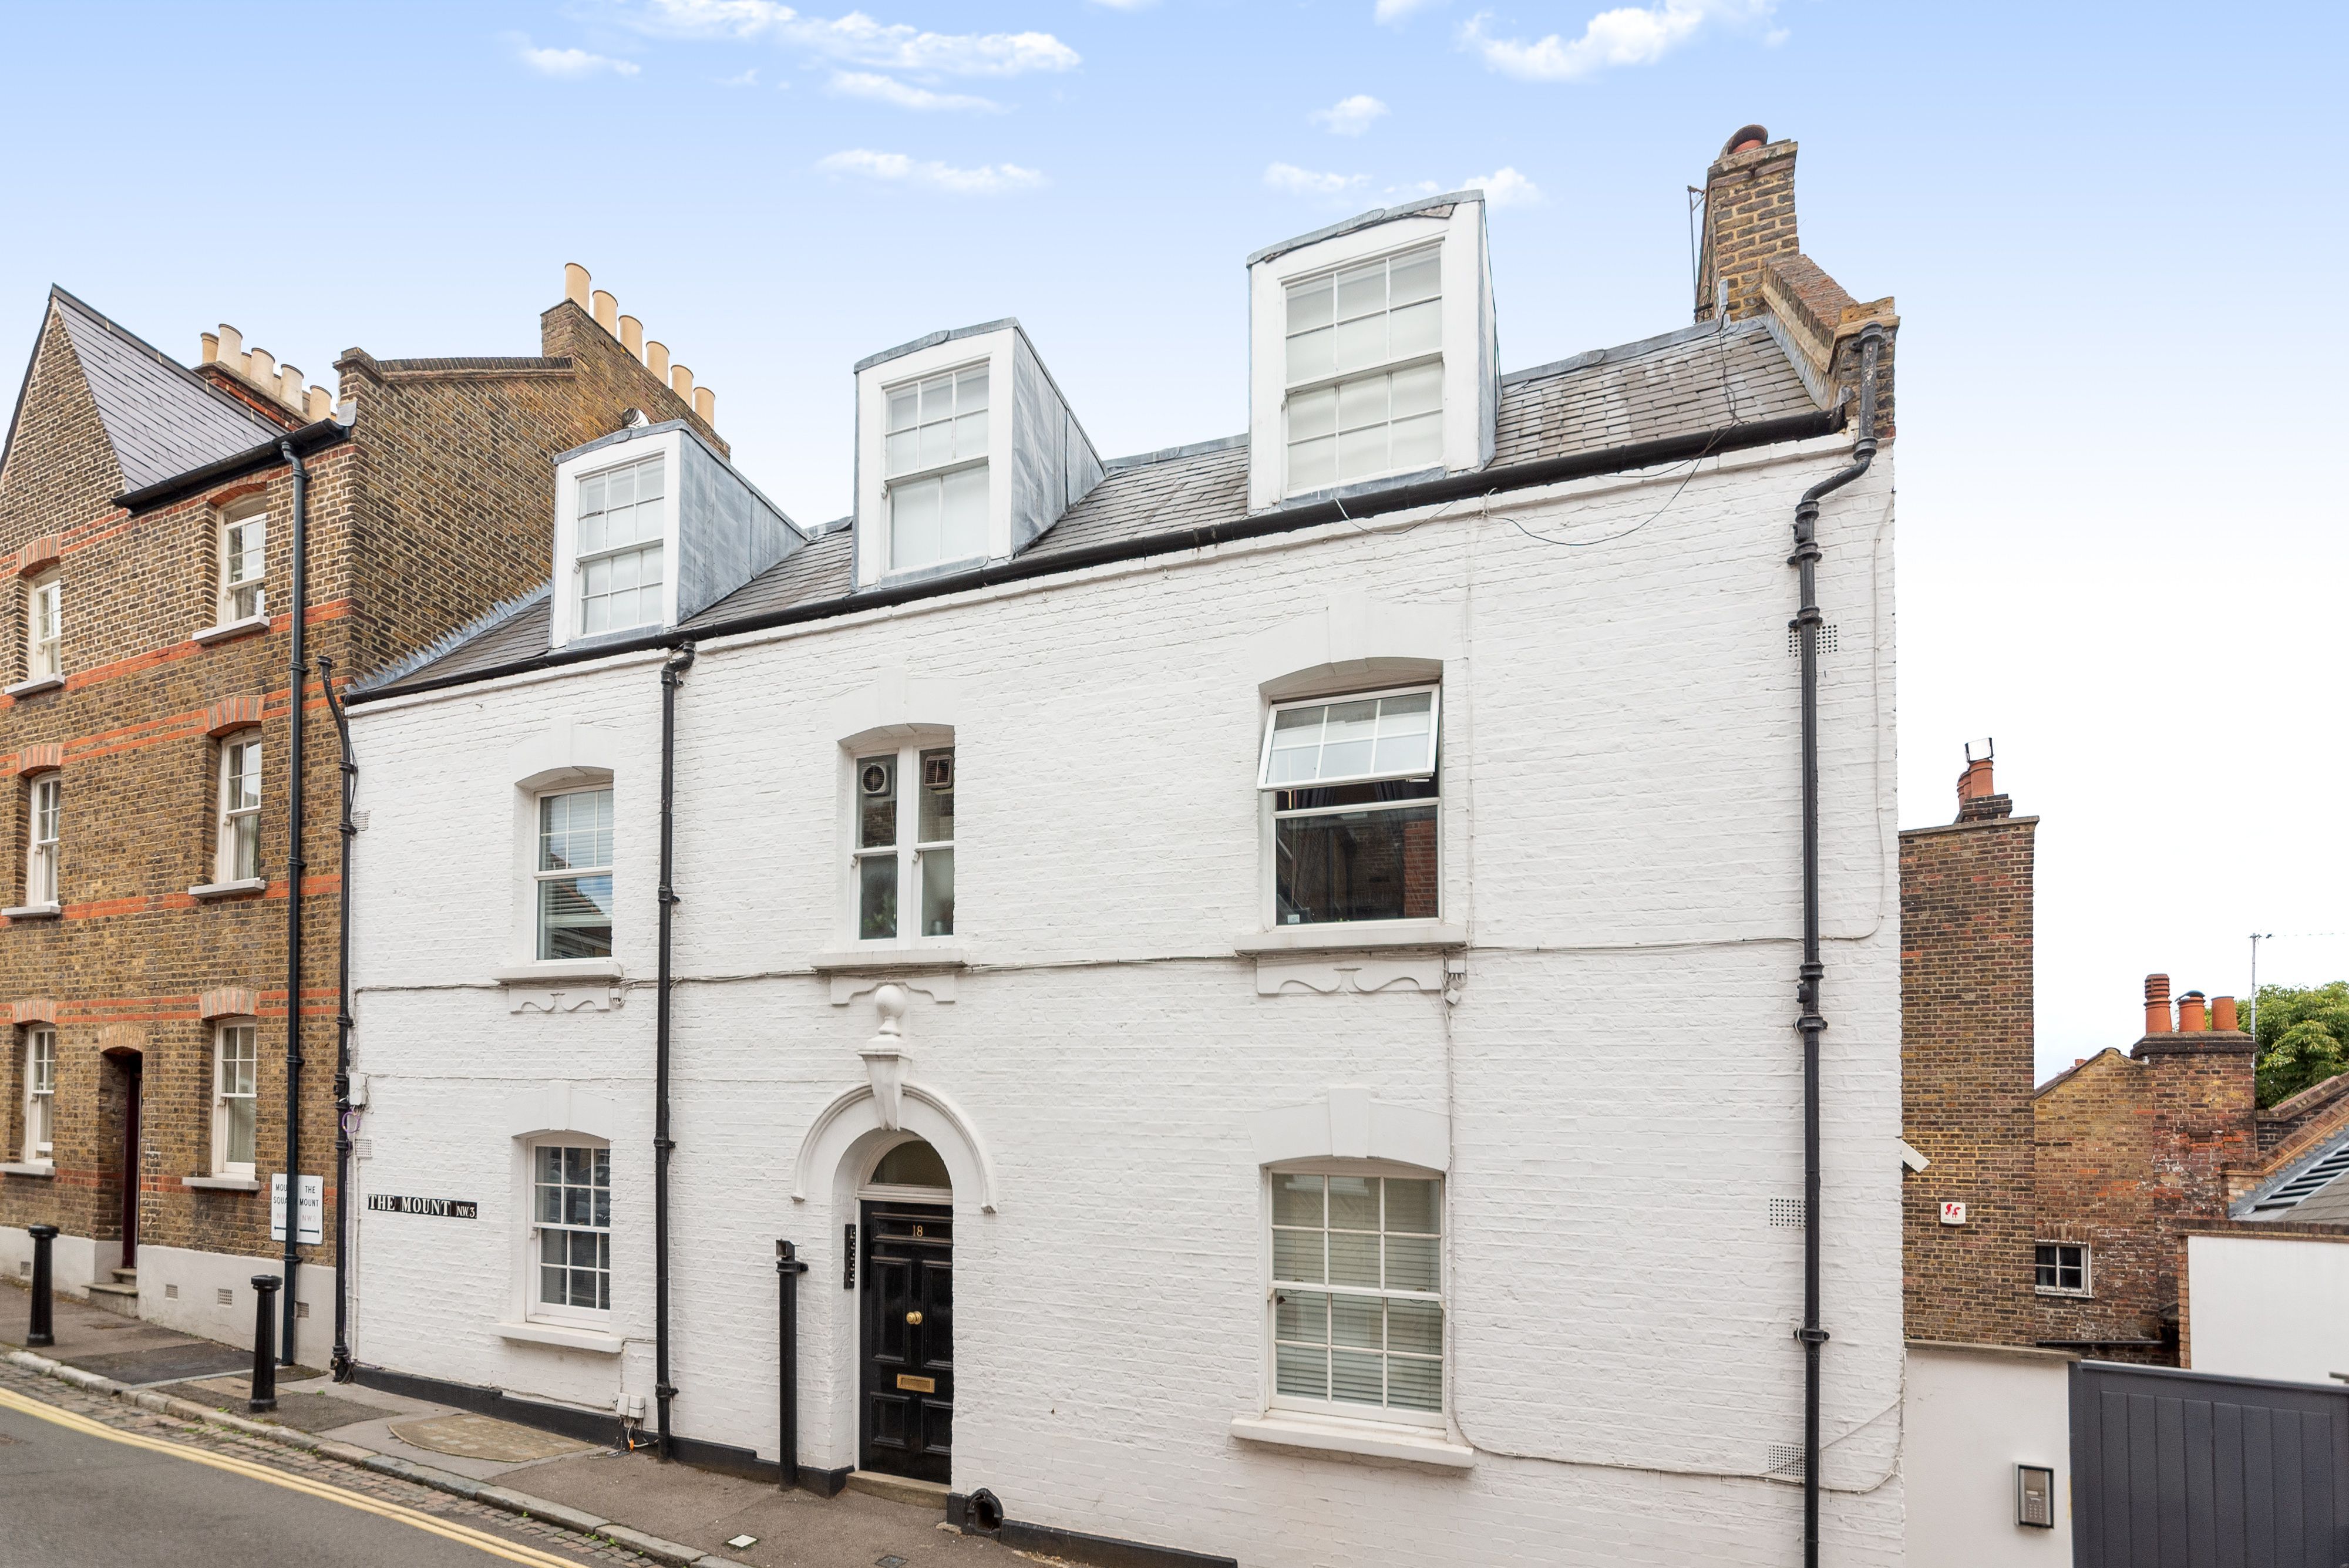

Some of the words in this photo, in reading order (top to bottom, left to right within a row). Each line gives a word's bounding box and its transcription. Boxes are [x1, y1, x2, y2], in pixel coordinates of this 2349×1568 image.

[275, 1183, 287, 1192] MOU
[305, 1186, 315, 1194] THE
[273, 1196, 287, 1205] SQUA
[299, 1198, 319, 1207] MOUNT
[368, 1194, 395, 1211] THE
[402, 1196, 450, 1216] MOUNT
[913, 1224, 923, 1237] 18
